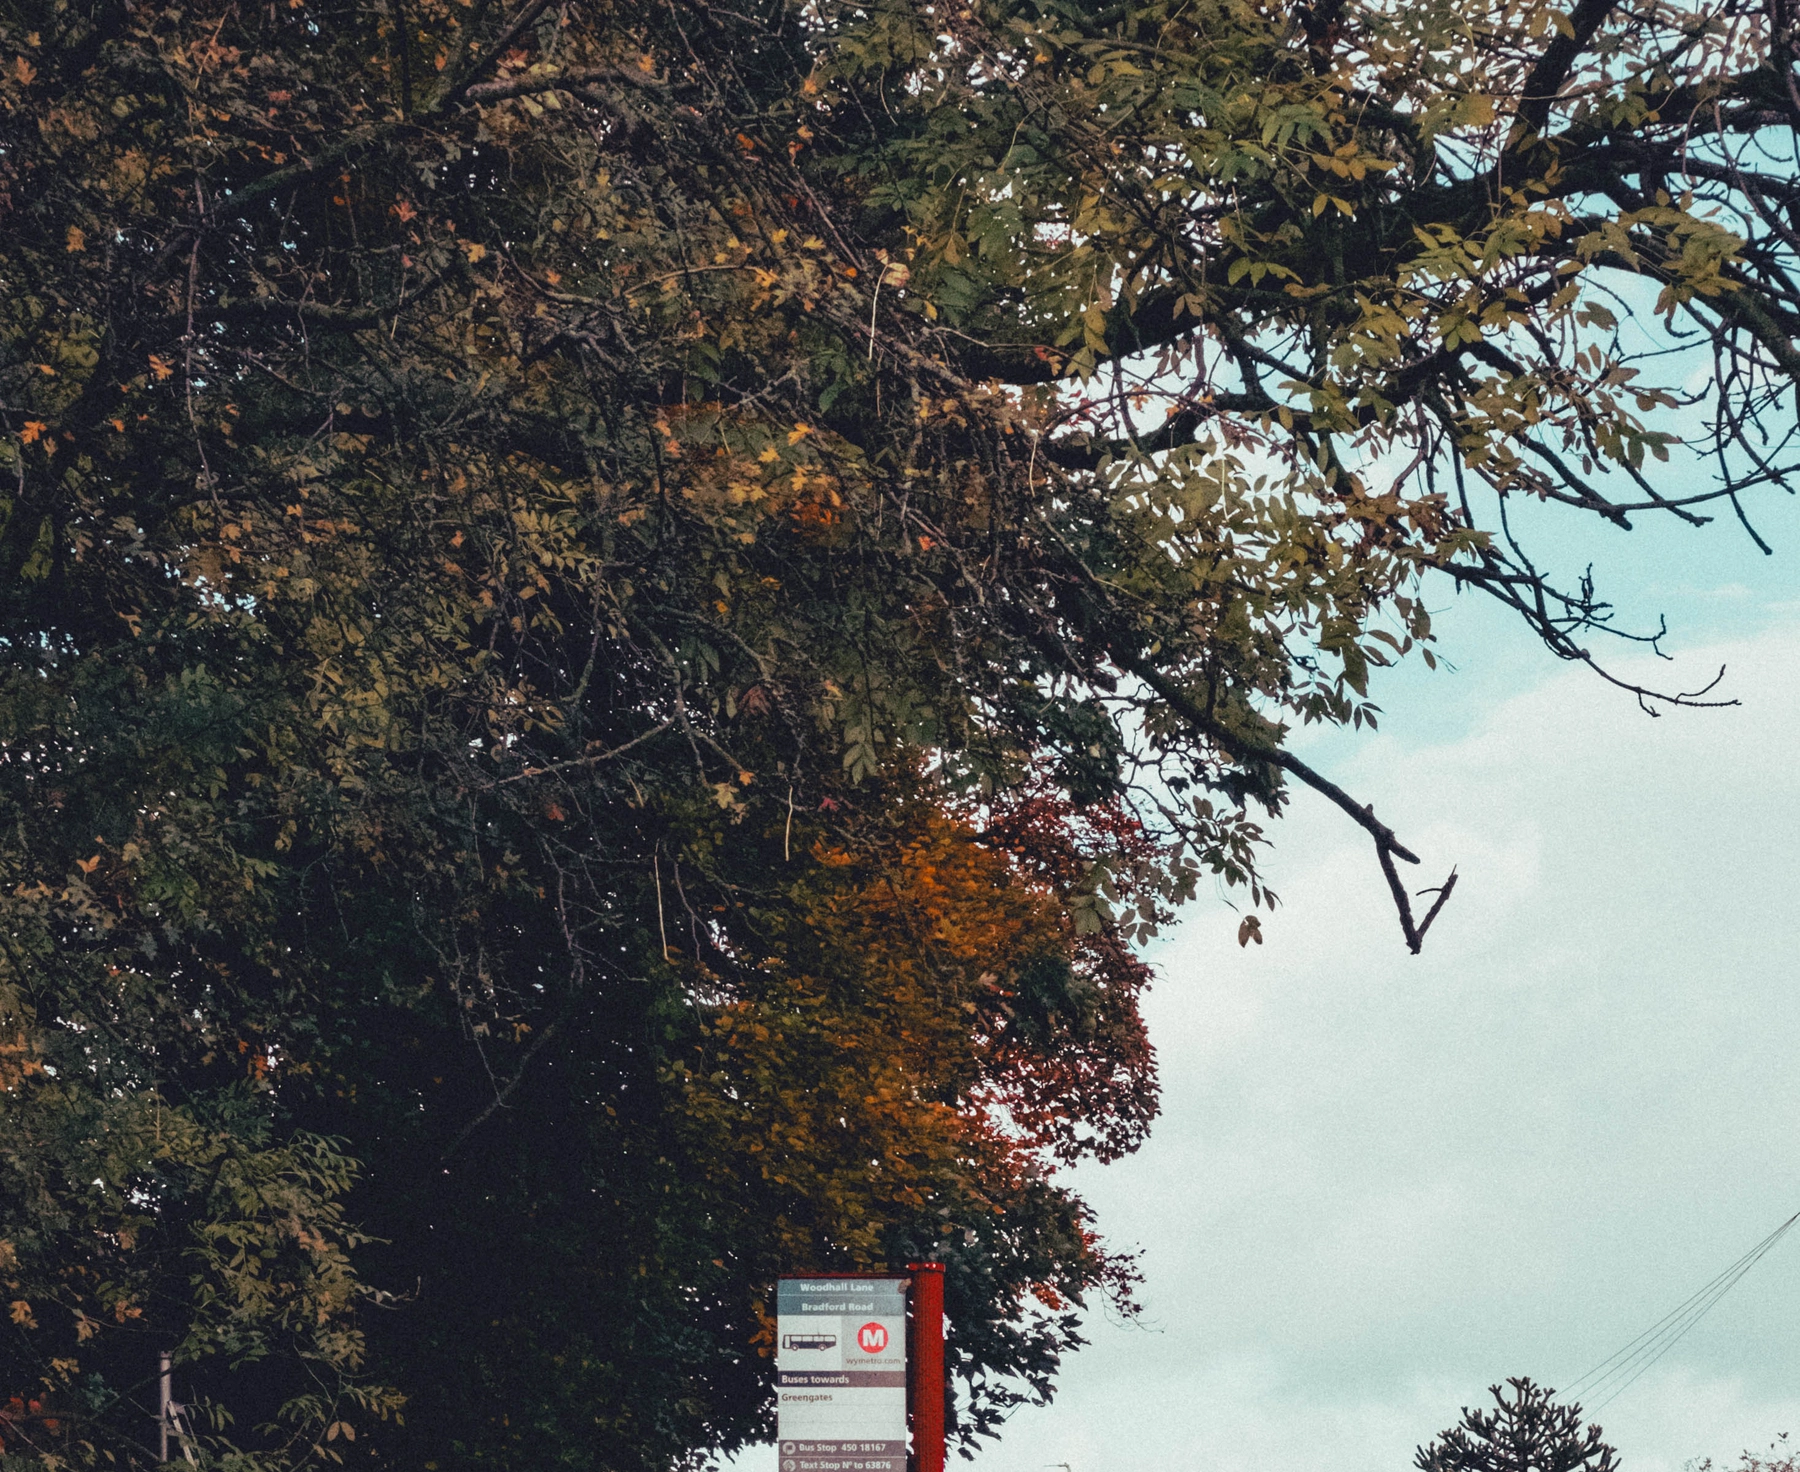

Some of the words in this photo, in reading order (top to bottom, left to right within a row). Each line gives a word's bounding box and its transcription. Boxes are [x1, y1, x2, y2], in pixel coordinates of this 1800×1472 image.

[800, 1282, 848, 1292] Woodhall
[850, 1282, 874, 1292] Lane
[801, 1303, 846, 1312] Bradford
[848, 1303, 874, 1312] Road
[862, 1329, 885, 1347] M
[846, 1358, 901, 1366] wymetro.com
[781, 1375, 809, 1384] Buses
[811, 1375, 850, 1384] towards
[781, 1393, 833, 1403] Greengates
[799, 1443, 815, 1452] Bus
[816, 1443, 837, 1453] Stop
[841, 1443, 857, 1452] 450
[860, 1443, 886, 1452] 18167
[799, 1461, 818, 1470] Text
[819, 1461, 840, 1471] Stop
[854, 1462, 863, 1470] to
[865, 1461, 891, 1470] 63876
